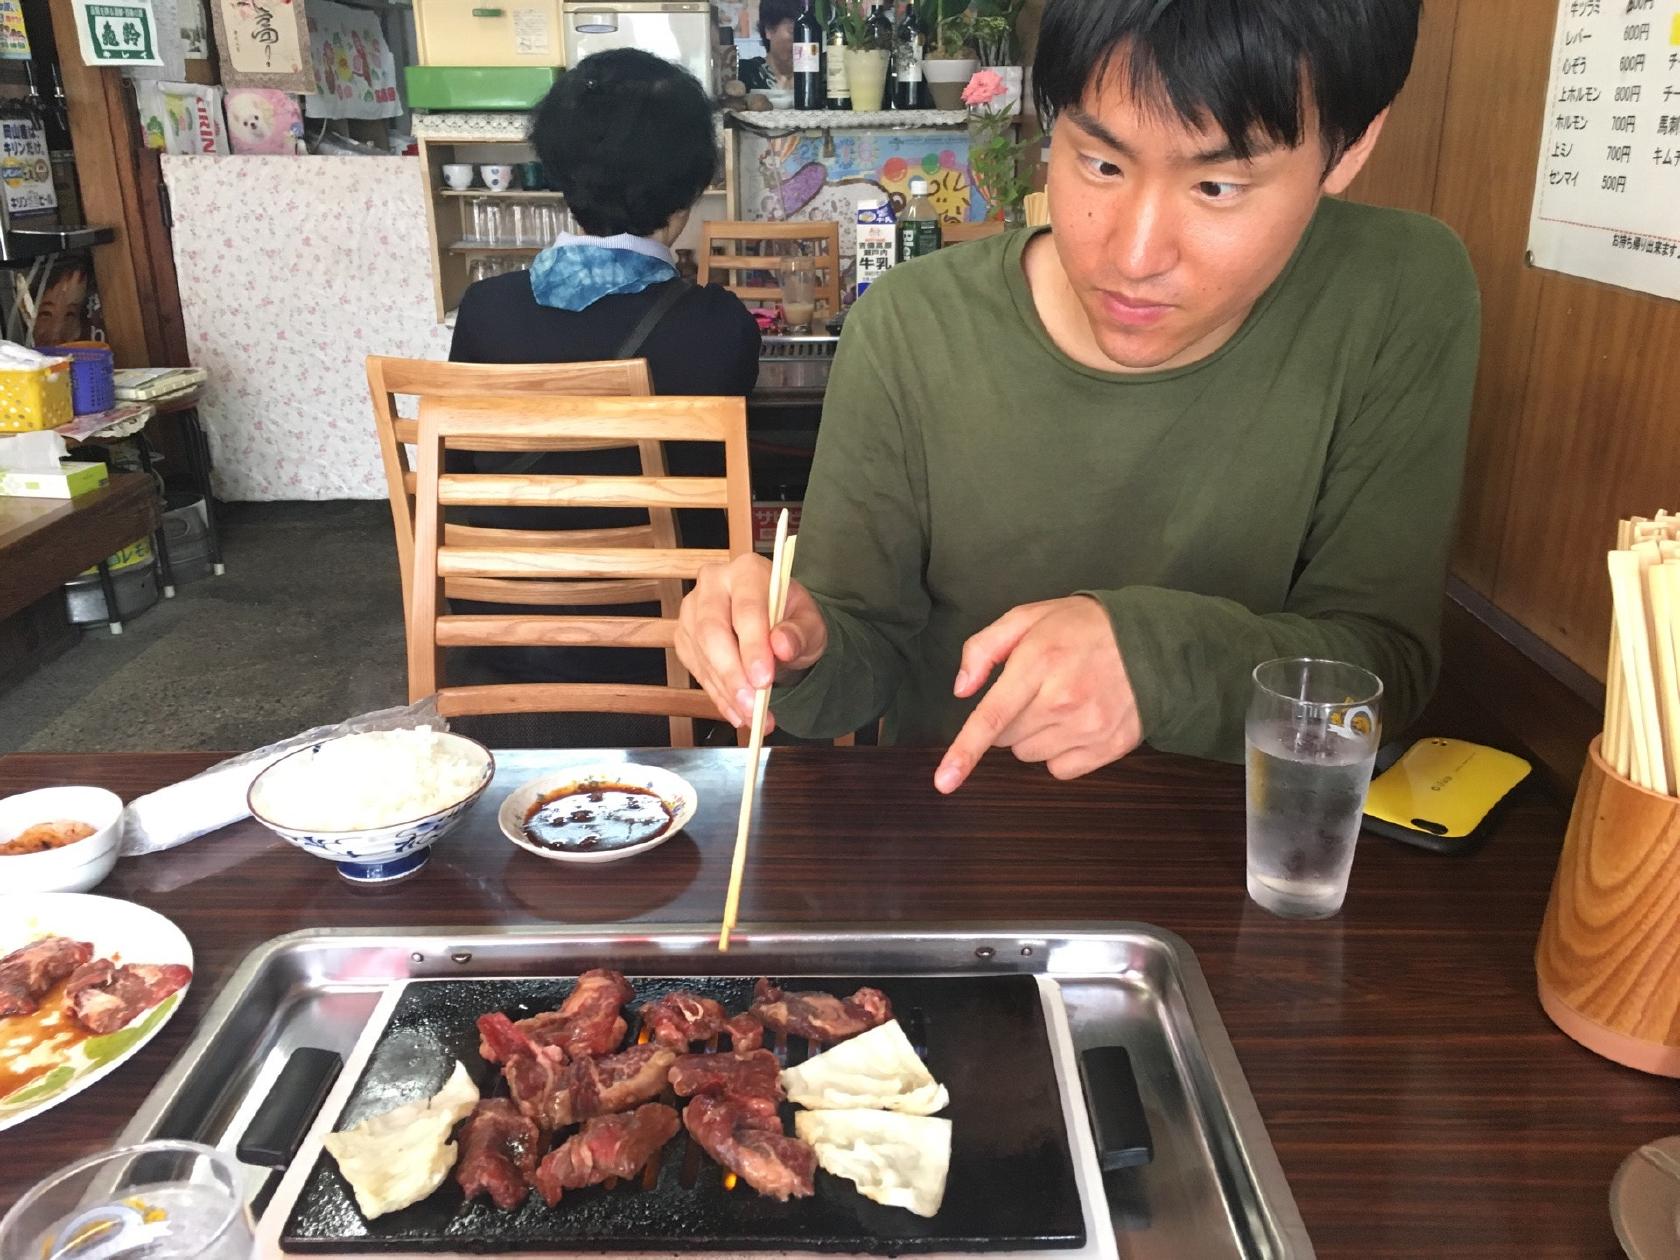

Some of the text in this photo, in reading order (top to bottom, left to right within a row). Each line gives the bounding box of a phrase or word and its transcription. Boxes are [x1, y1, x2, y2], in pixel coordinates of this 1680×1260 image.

[1565, 28, 1592, 45] レバー
[1562, 54, 1645, 74] 心ぞう 600円
[1558, 85, 1642, 102] 上ホルモン 800円
[1556, 114, 1636, 133] ホルモン 700円
[1551, 142, 1631, 163] 上ミノ 700円
[1549, 171, 1627, 193] センマイ 500円
[859, 257, 892, 270] 牛乳
